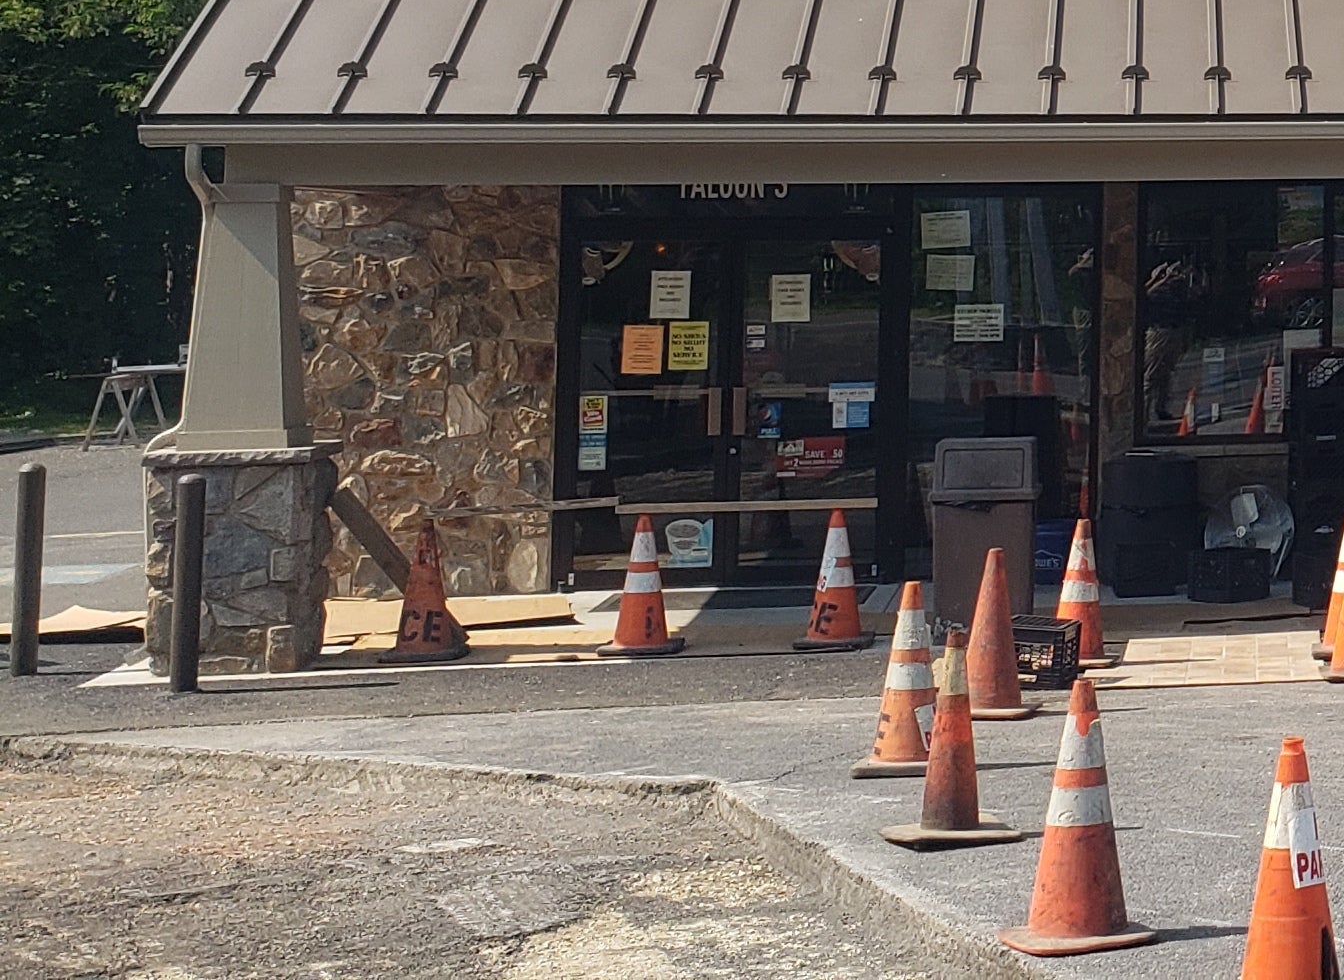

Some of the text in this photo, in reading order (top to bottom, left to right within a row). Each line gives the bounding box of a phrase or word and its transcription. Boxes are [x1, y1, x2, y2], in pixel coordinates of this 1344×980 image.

[680, 182, 789, 199] FALOONS
[804, 450, 826, 459] SAVE
[400, 609, 443, 643] CE
